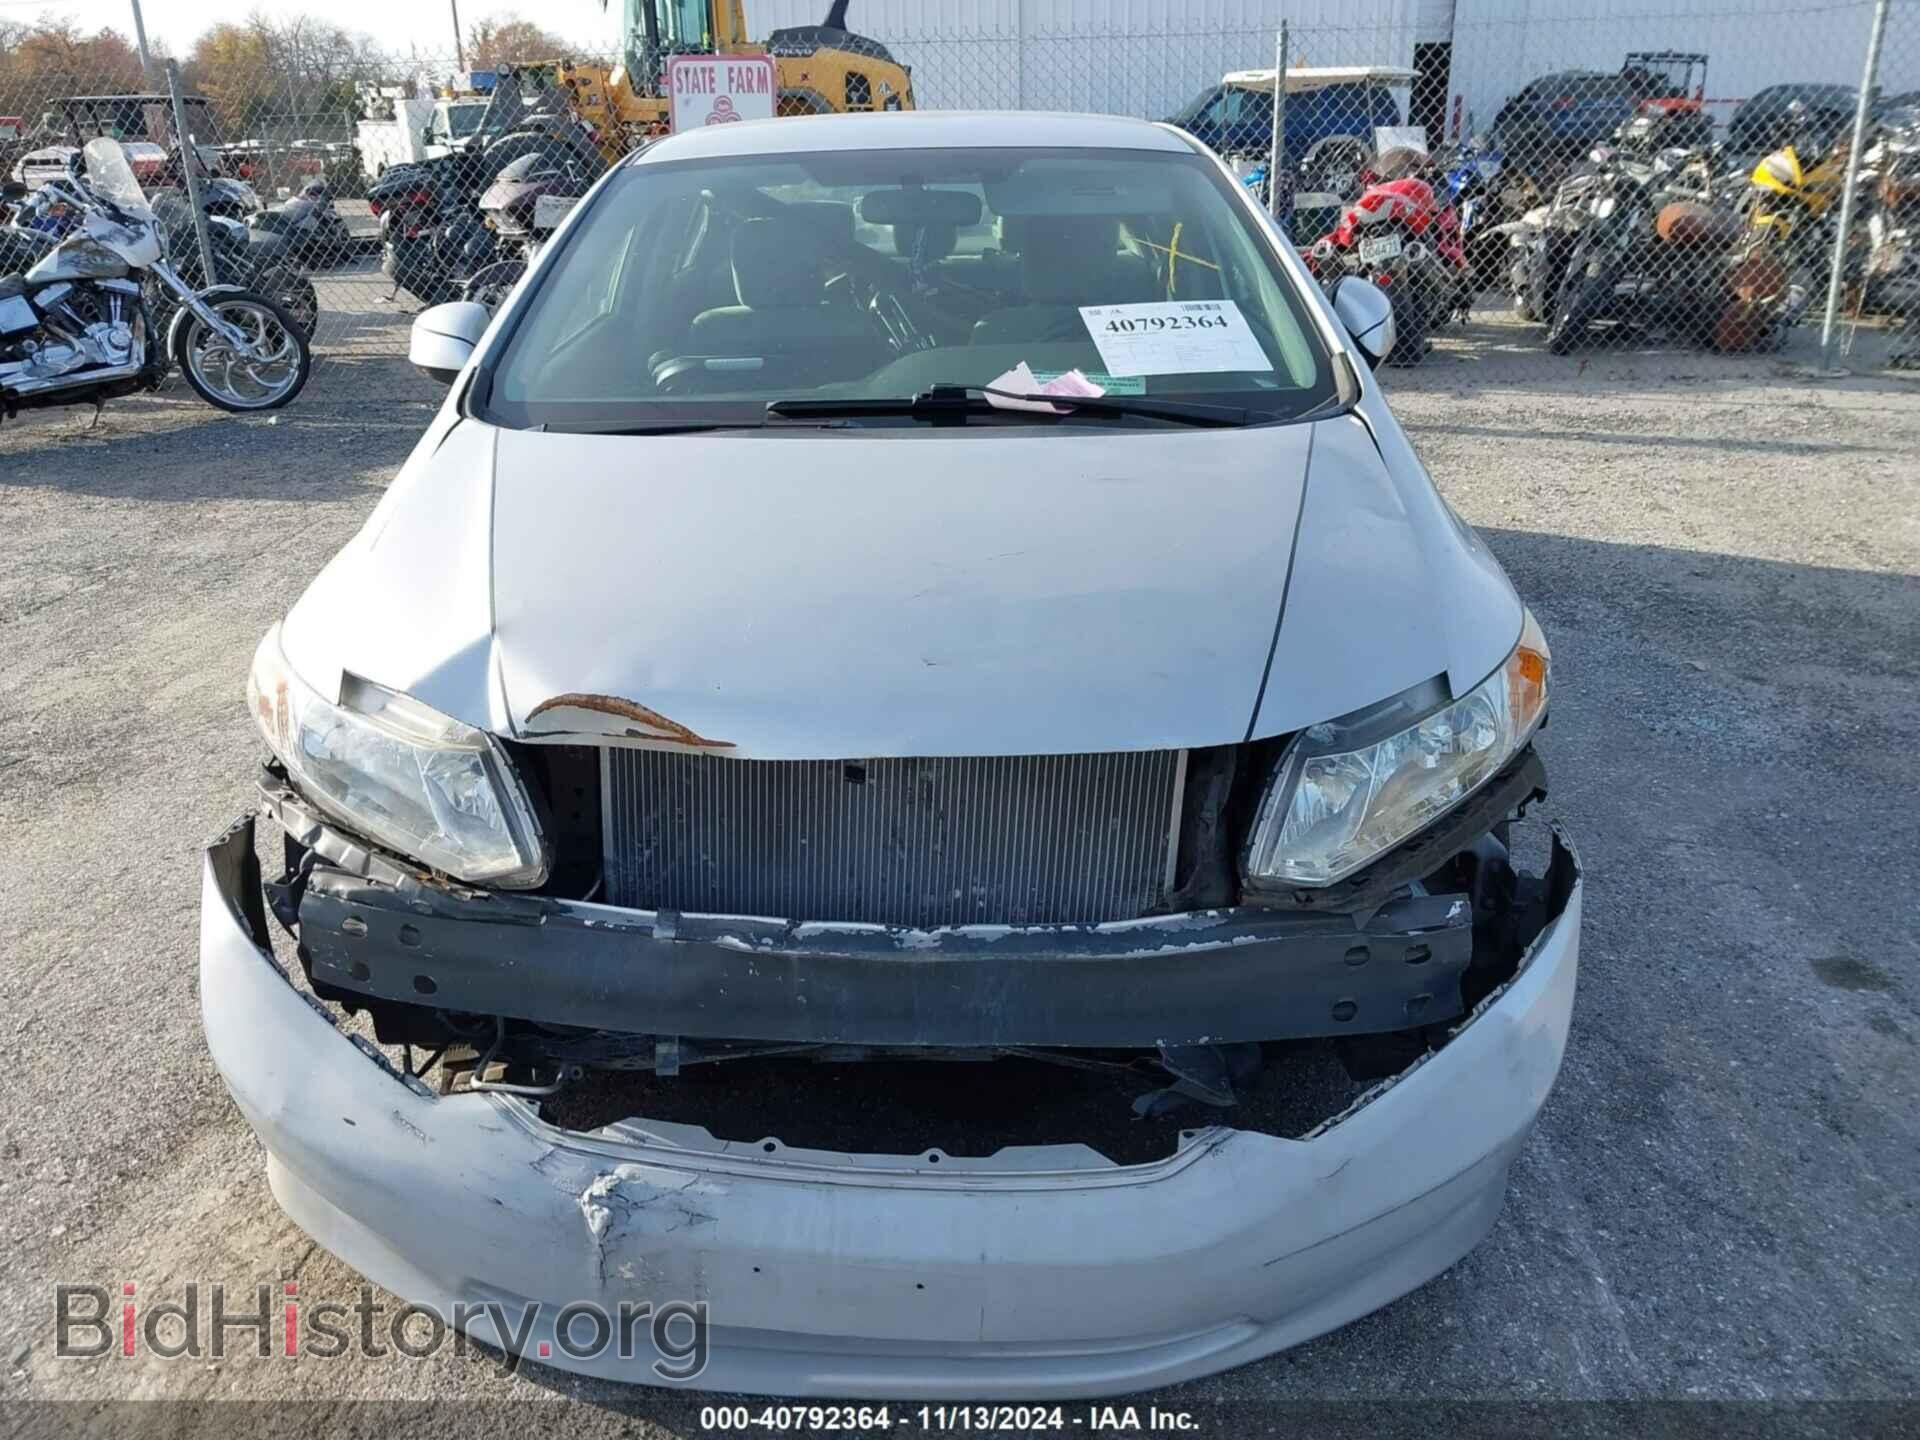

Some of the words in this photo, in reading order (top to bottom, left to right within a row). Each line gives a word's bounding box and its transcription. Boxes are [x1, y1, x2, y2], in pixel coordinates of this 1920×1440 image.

[676, 66, 715, 93] STATE
[728, 66, 768, 93] FARM
[1105, 315, 1228, 332] 40792364
